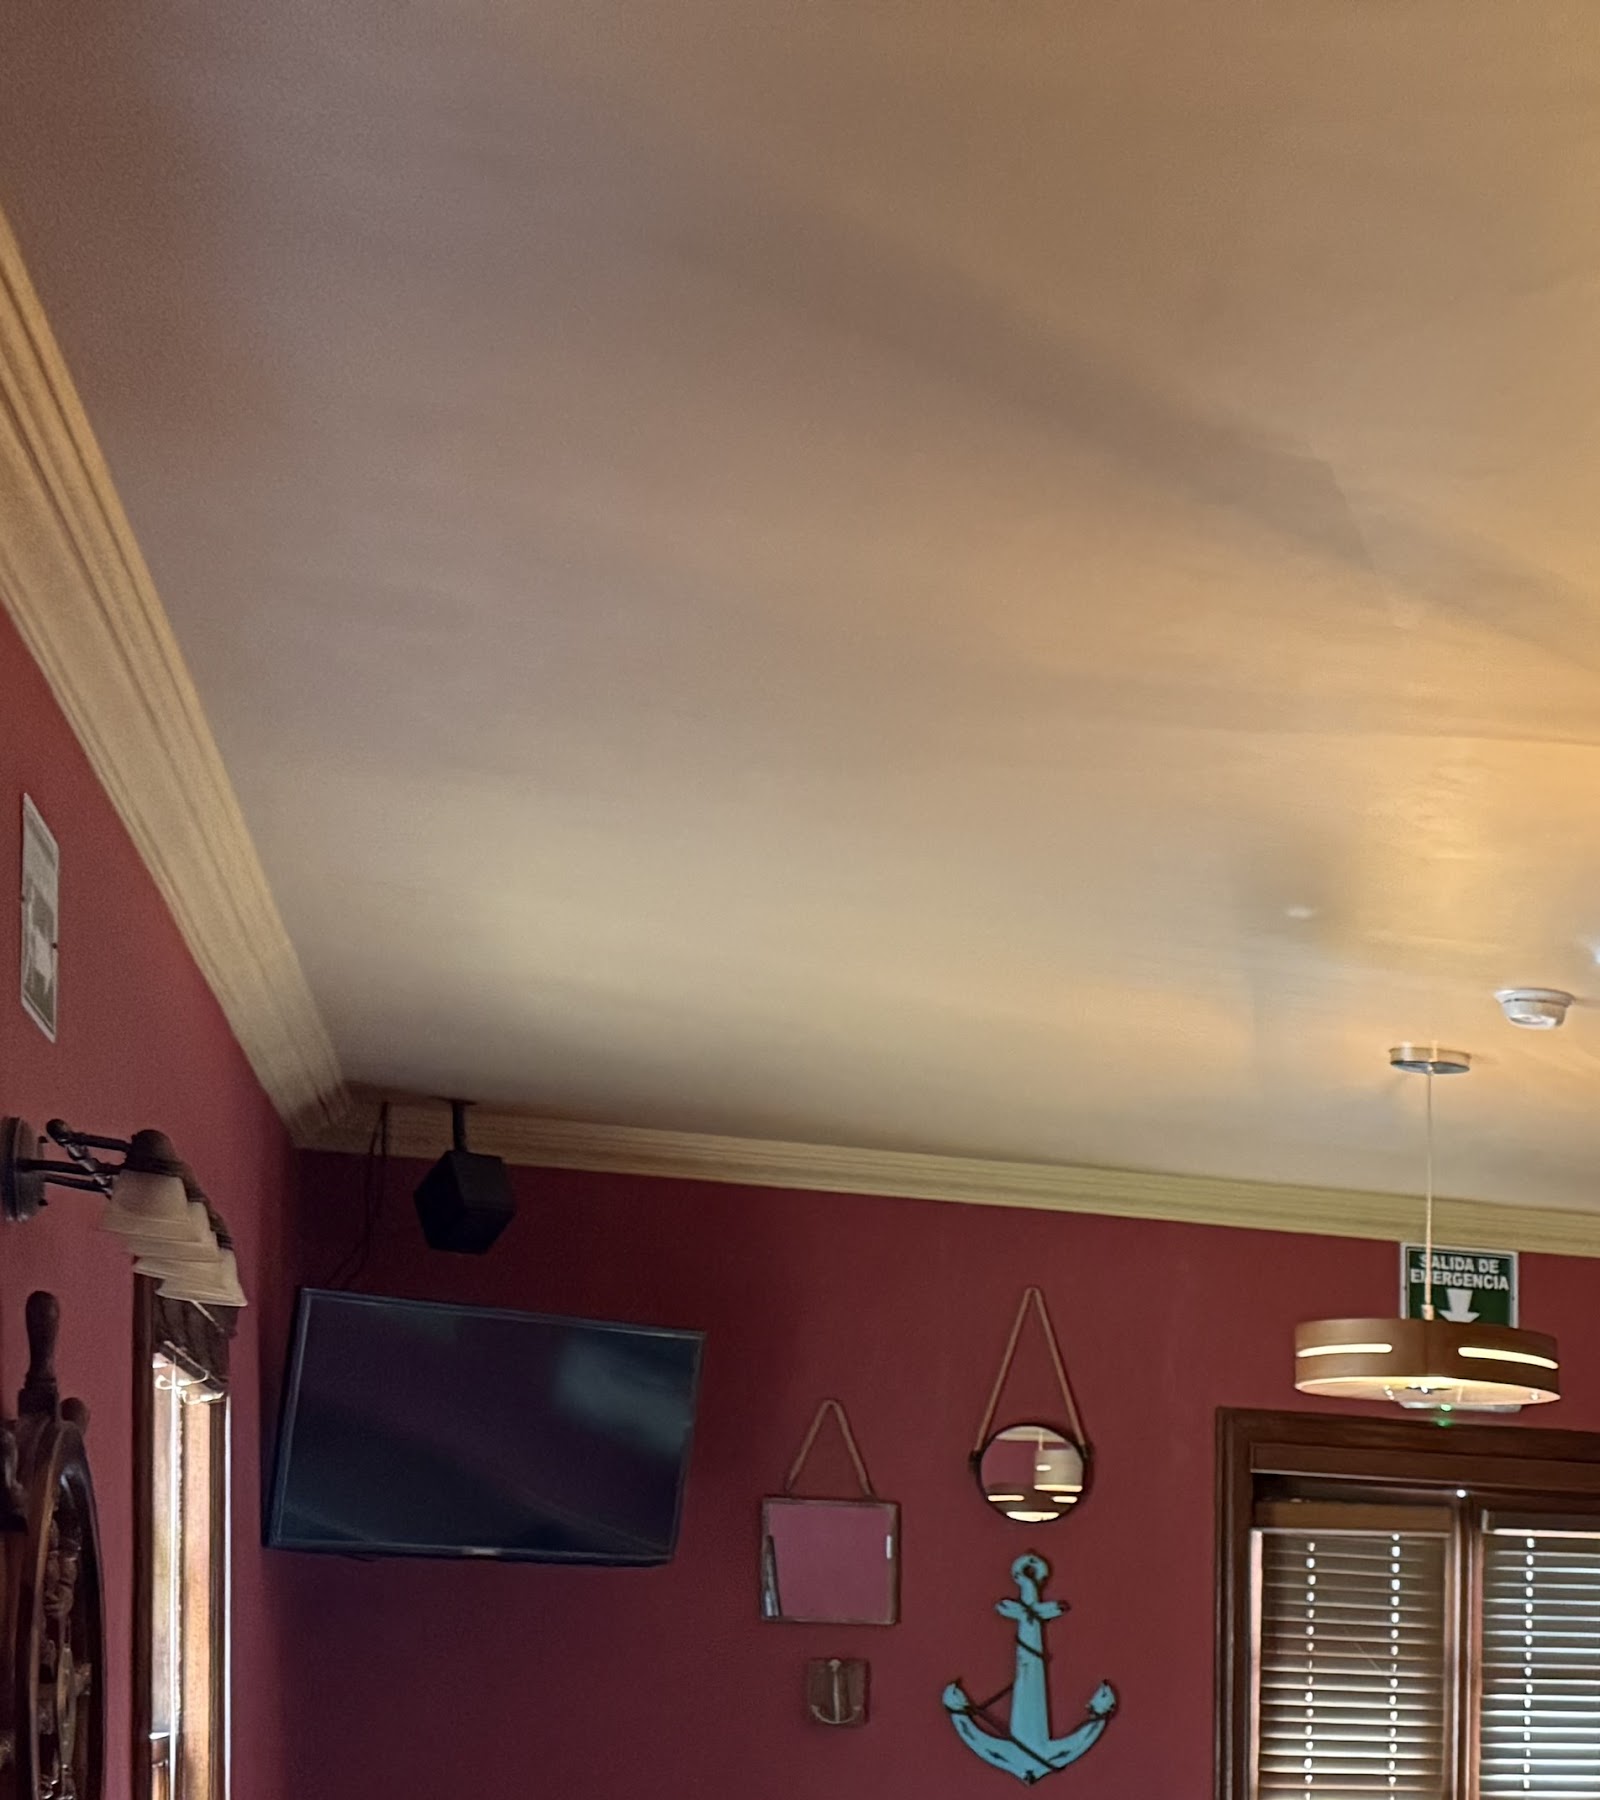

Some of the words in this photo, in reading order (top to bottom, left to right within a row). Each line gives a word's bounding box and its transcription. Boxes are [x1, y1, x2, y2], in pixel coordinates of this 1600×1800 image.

[1419, 1253, 1475, 1273] SALIDA
[1478, 1258, 1500, 1274] DE
[1410, 1269, 1509, 1290] EERGENCIA
